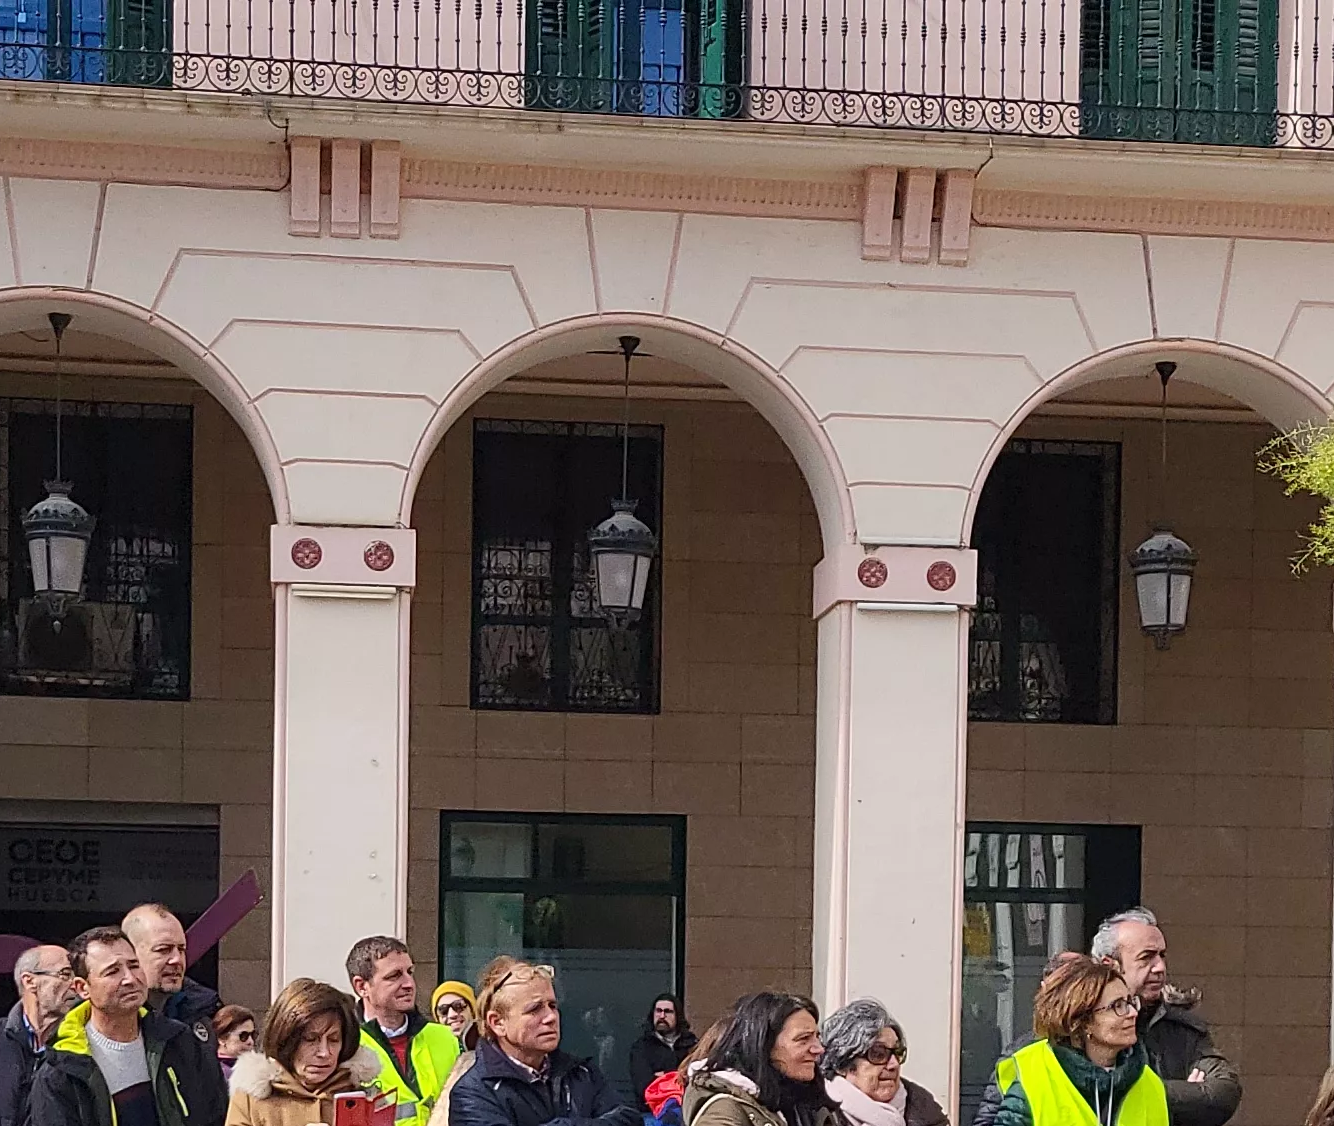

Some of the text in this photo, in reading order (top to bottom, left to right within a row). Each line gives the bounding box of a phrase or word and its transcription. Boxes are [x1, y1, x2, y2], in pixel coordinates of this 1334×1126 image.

[8, 838, 101, 865] CEOE
[8, 867, 101, 886] CEPYME
[8, 888, 101, 903] HUESCA
